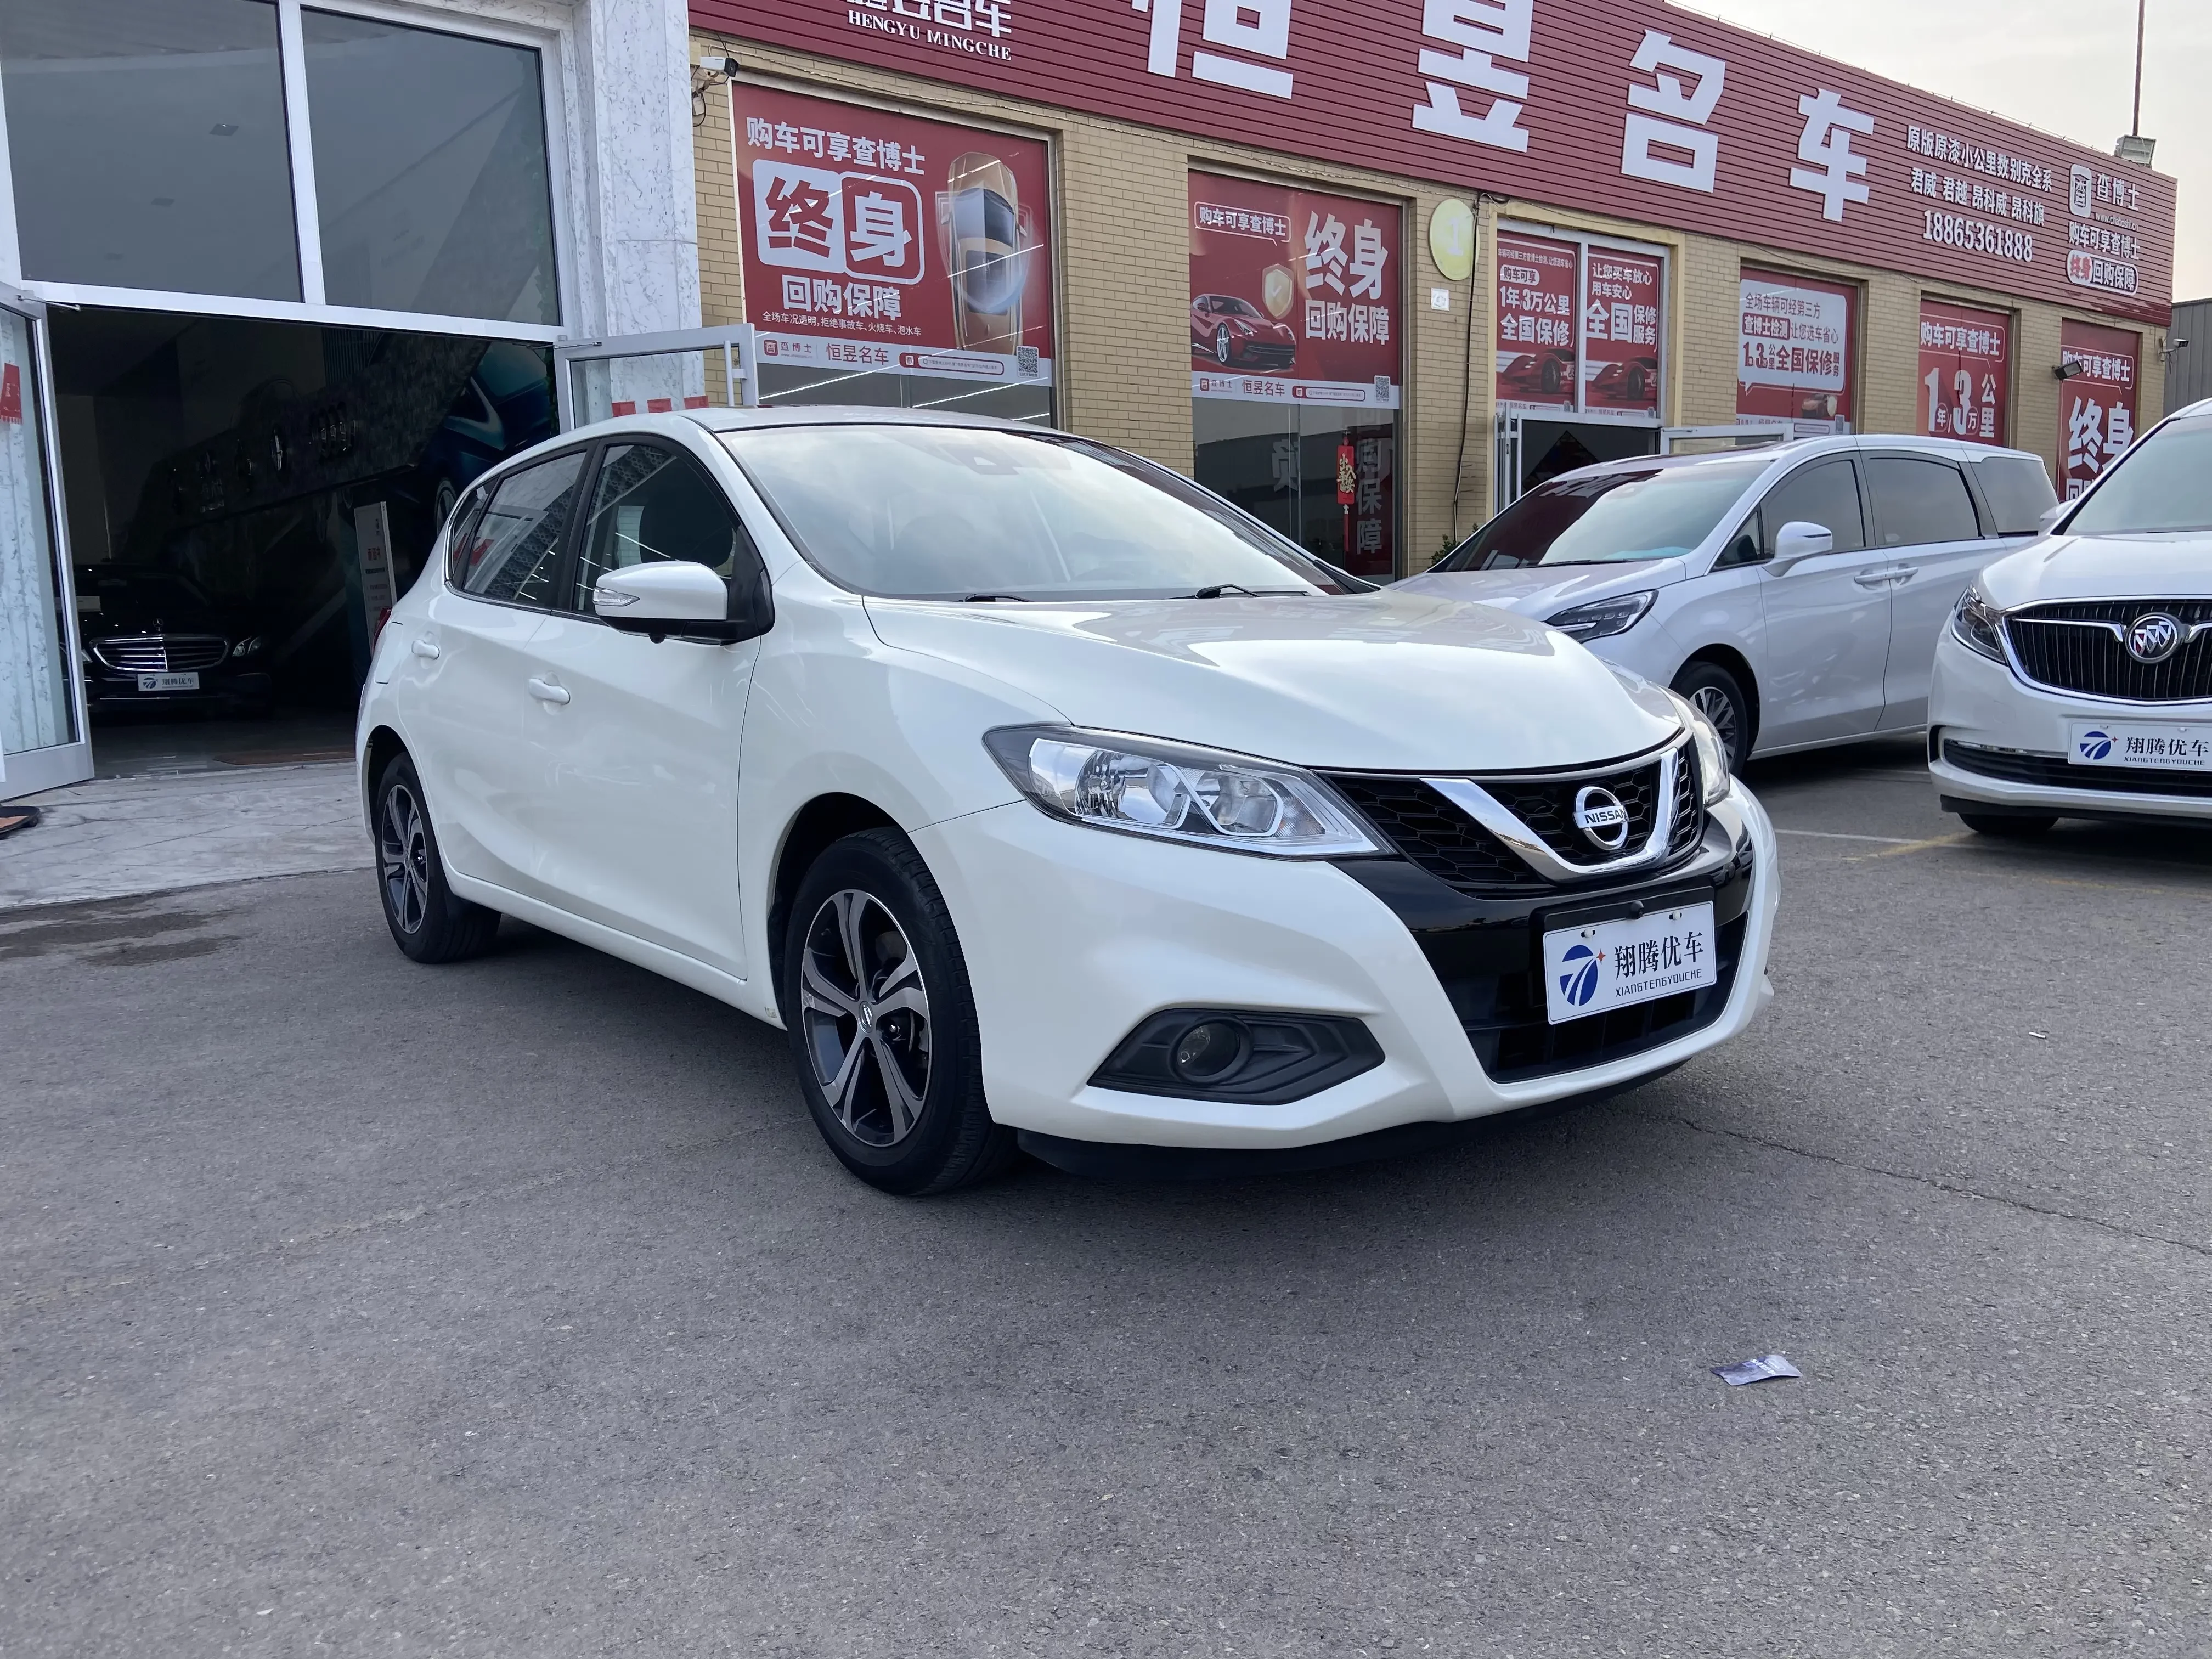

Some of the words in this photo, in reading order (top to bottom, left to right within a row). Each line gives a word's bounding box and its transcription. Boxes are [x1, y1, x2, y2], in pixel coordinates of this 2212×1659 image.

[848, 10, 920, 40] HENGYU
[927, 29, 1012, 60] MINGCHE
[746, 116, 926, 175] 购车可享查博士
[1907, 125, 2052, 191] 原版原漆小公里数别克全系
[1911, 167, 1937, 198] 君威
[1943, 176, 1968, 205] 君越
[1972, 184, 2007, 216] 昂科威
[2011, 196, 2045, 226] 昂科旗
[2096, 173, 2140, 211] 查博士
[765, 175, 912, 268] 终身
[1199, 206, 1286, 238] 购车可享查博士
[1922, 210, 2033, 262] 18865361888
[1304, 210, 1389, 301] 终身
[2068, 221, 2140, 260] 购车可享查博士
[1504, 266, 1536, 283] 购车可享
[1592, 263, 1652, 285] 让您买车放心
[1592, 281, 1632, 300] 用车安心
[2093, 259, 2135, 291] 回购保障
[781, 274, 901, 321] 回购保障
[1745, 292, 1821, 319] 全场车辆可经第三方
[1305, 300, 1389, 345] 回购保障
[1500, 313, 1570, 347] 全国保修
[1587, 298, 1633, 343] 全国
[1634, 304, 1656, 325] 保修
[1633, 325, 1656, 345] 服务
[1744, 315, 1788, 339] 查博士检测
[1791, 323, 1838, 344] 让您选车省心
[780, 341, 812, 353] 查博士
[826, 342, 889, 365] 恒昱名车
[1920, 321, 2001, 356] 购车可享查博士
[1776, 345, 1832, 376] 全国保修
[1242, 379, 1285, 396] 恒昱名车
[2068, 396, 2134, 474] 终身
[2124, 757, 2205, 766] XIANGTENGYOUCHE
[2126, 736, 2209, 757] 翔腾优车
[1584, 806, 1628, 825] NISSAN
[1613, 931, 1704, 981] 翔腾优车
[1615, 968, 1702, 998] XIANGTENGYOUCHE
